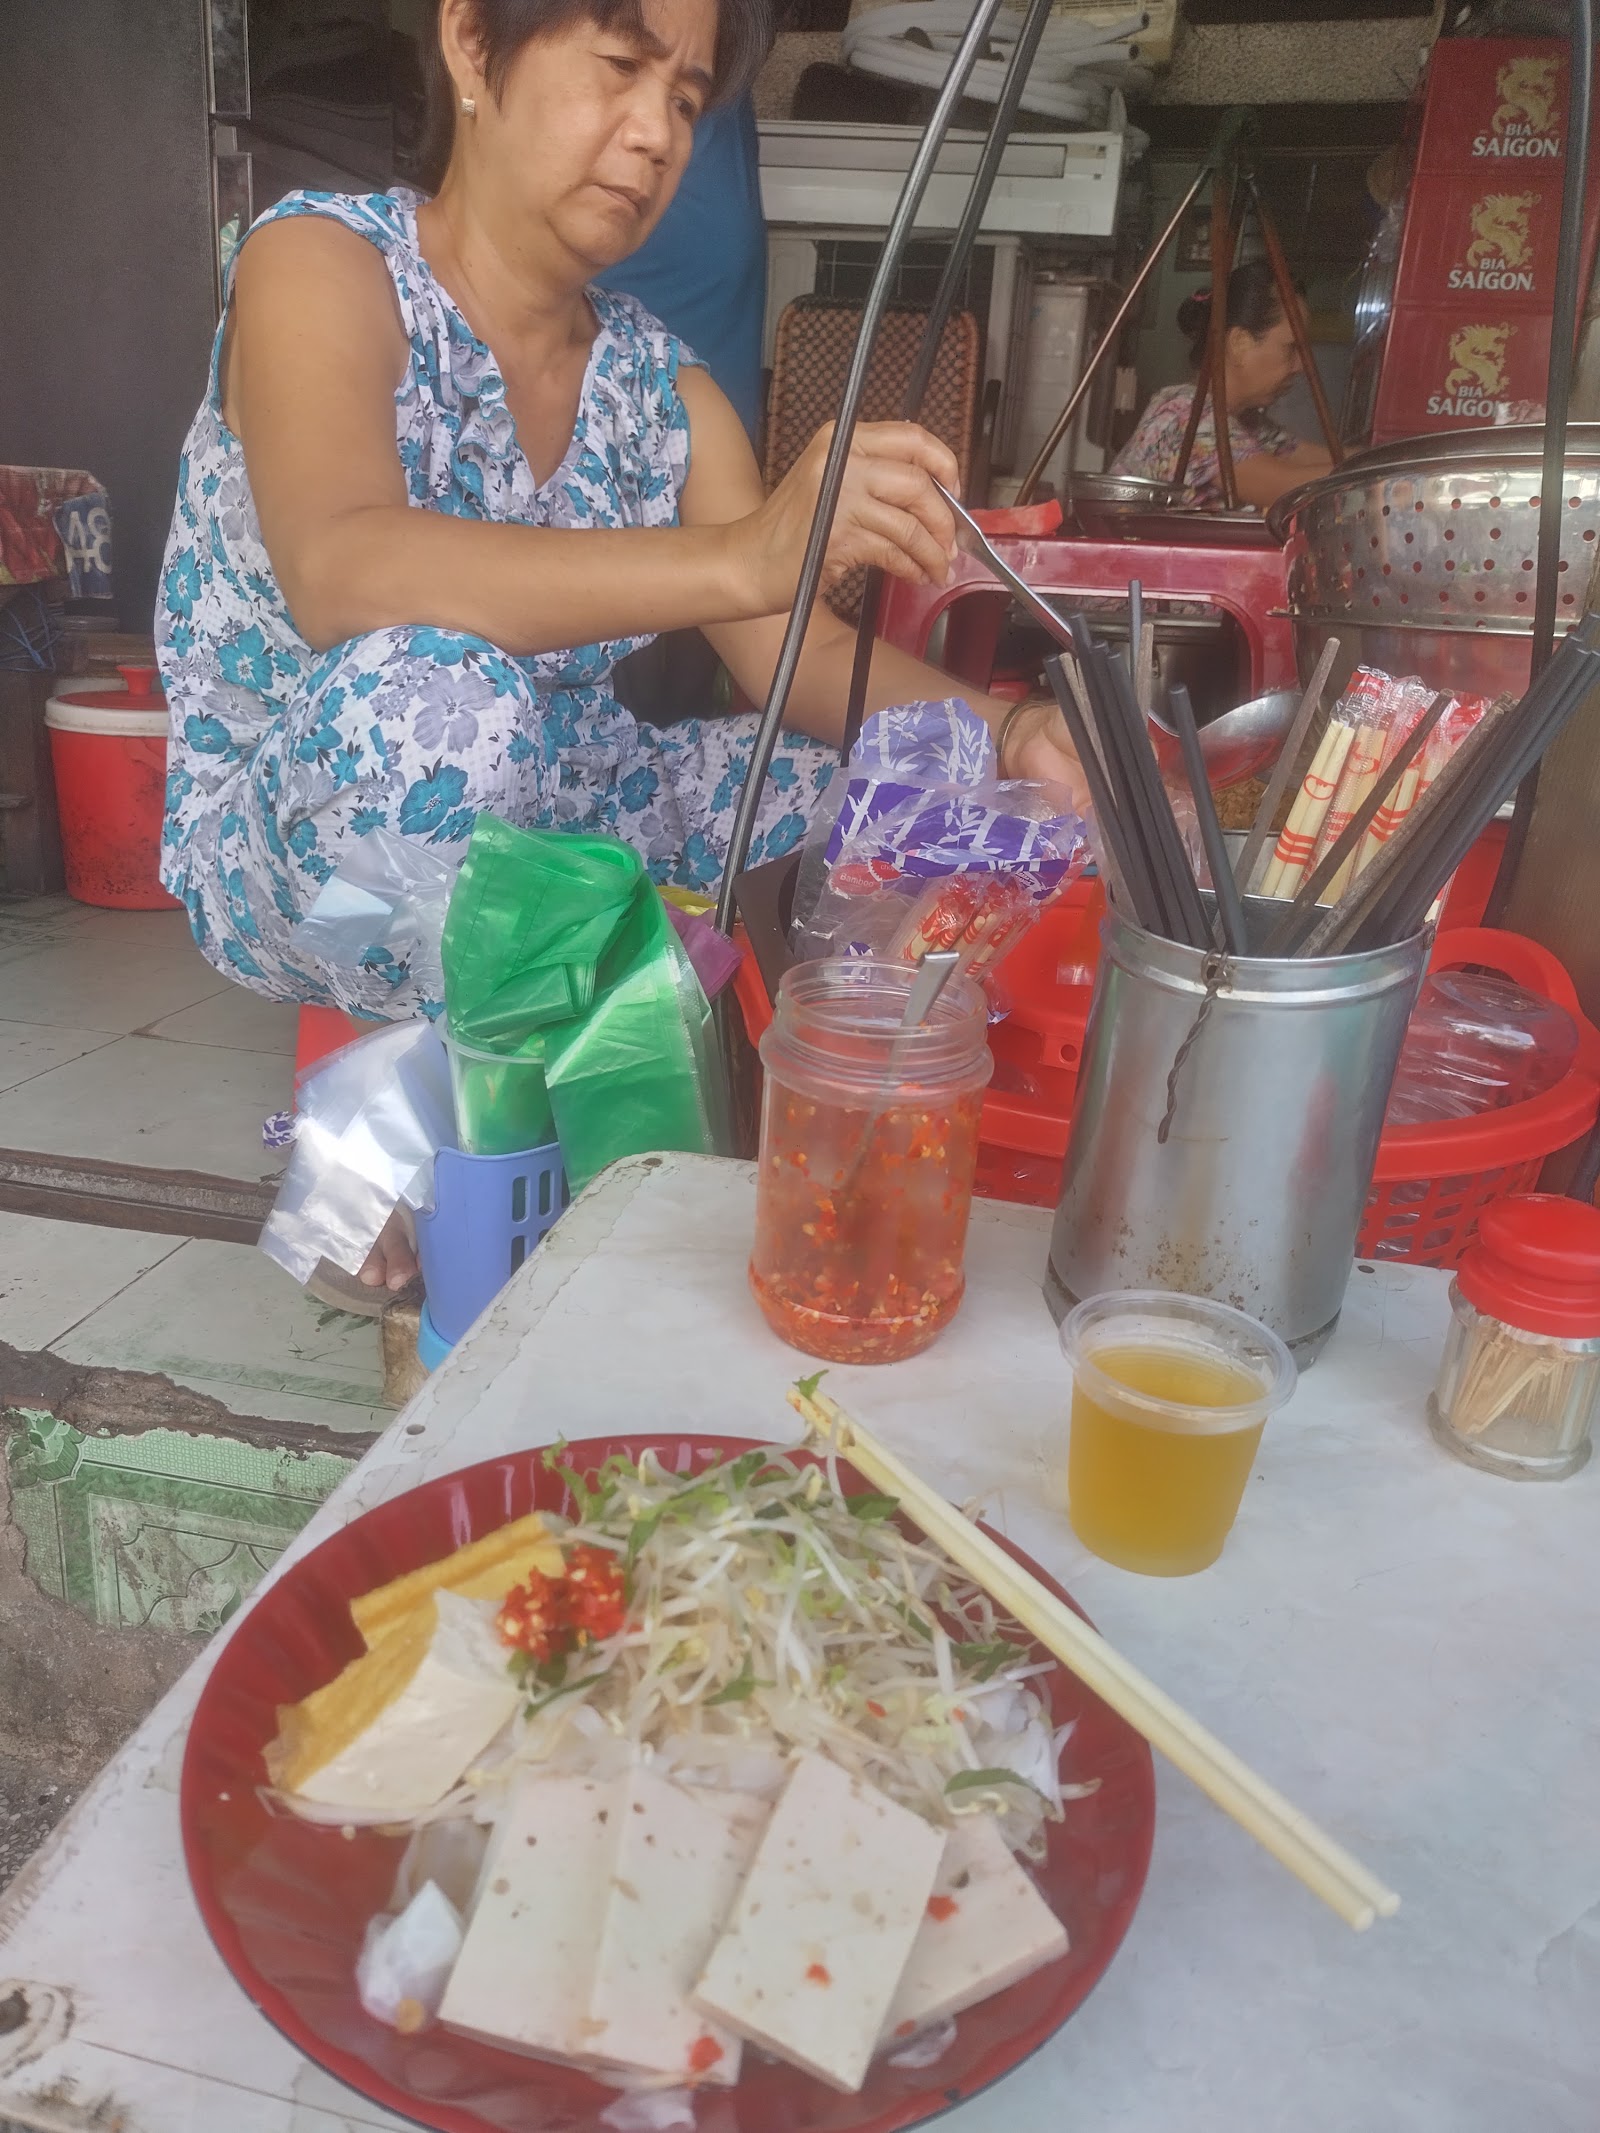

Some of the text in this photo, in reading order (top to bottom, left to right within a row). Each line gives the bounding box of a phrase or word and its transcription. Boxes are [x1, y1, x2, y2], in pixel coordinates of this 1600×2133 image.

[1505, 123, 1532, 136] BIA
[1472, 136, 1560, 157] SAIGON
[1480, 258, 1506, 270] BIA
[1447, 270, 1534, 291] SAIGON
[1458, 386, 1483, 398] BIA
[840, 873, 874, 888] Bamboo
